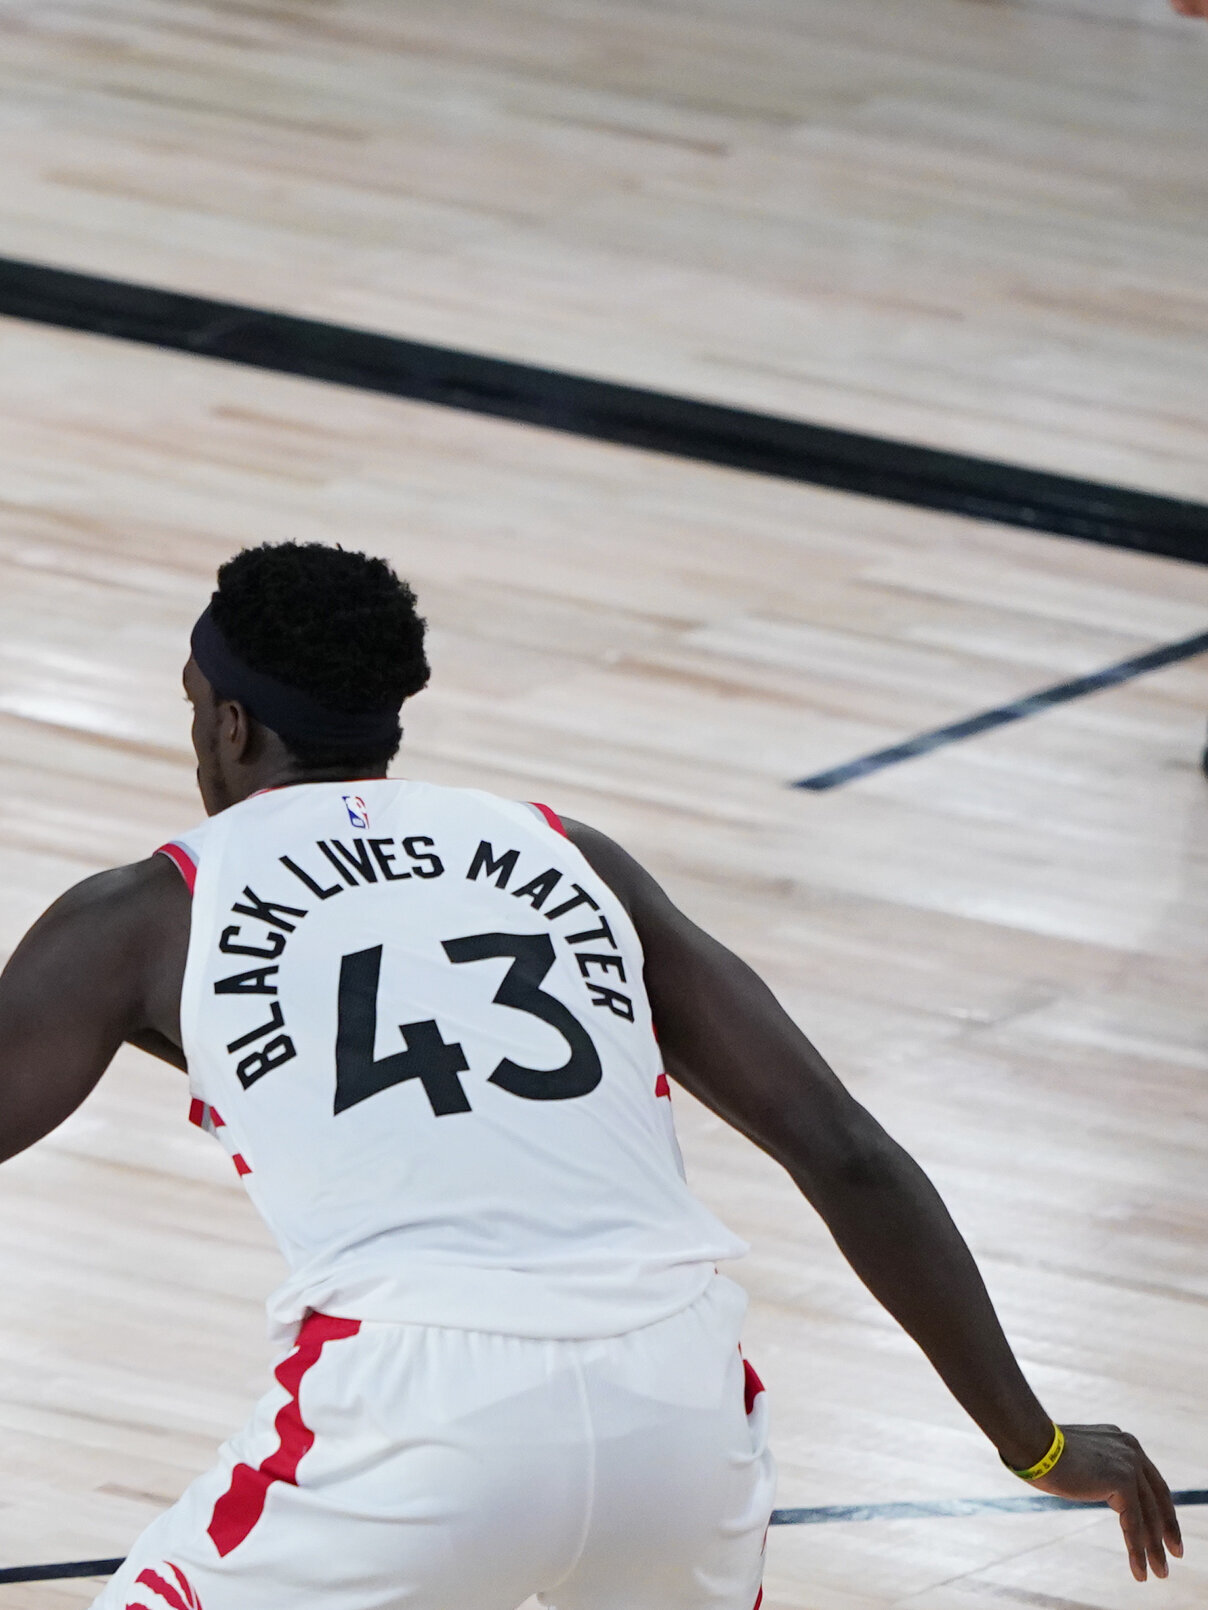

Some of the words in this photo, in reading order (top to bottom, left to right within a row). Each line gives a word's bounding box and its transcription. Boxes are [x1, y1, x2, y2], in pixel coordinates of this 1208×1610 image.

[214, 886, 308, 1090] BLACK
[279, 836, 445, 900] LIVES
[466, 840, 635, 1023] MATTER
[333, 932, 603, 1117] 43
